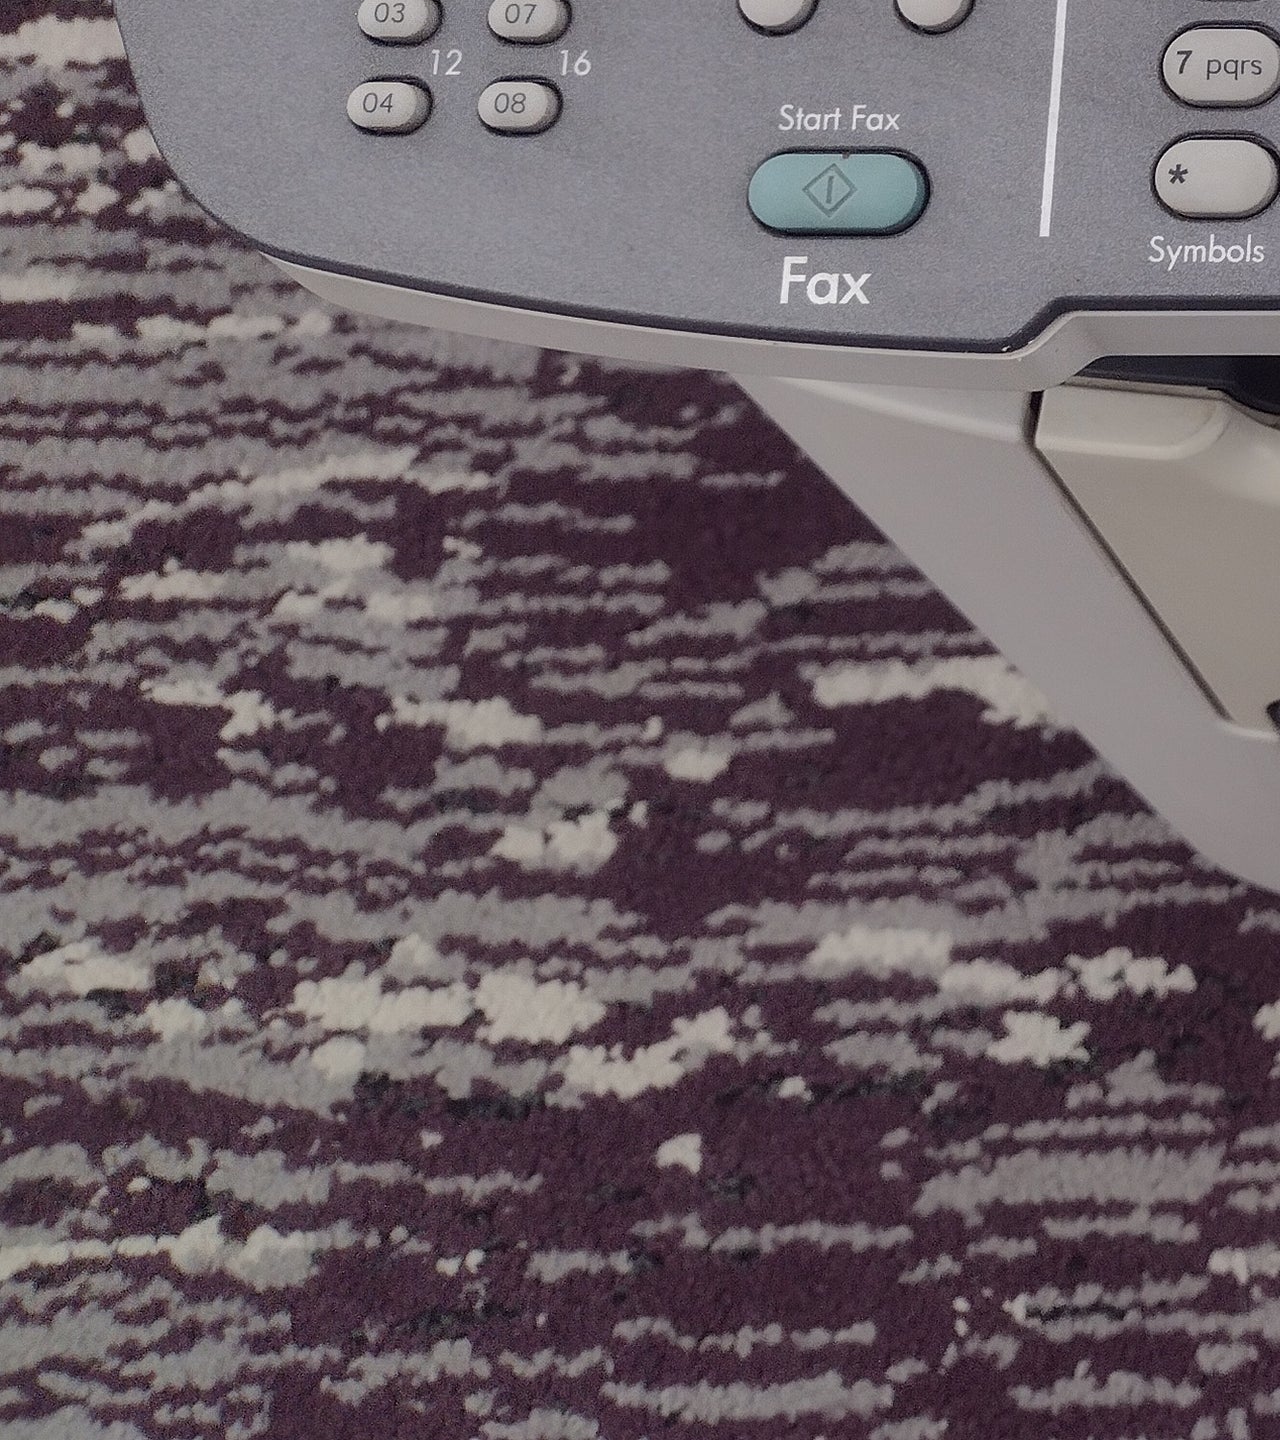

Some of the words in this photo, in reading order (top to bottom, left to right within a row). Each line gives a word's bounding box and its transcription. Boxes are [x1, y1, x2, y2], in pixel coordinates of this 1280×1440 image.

[374, 2, 406, 24] 03
[504, 3, 537, 25] 07
[431, 49, 463, 76] 12
[560, 49, 592, 77] 16
[1176, 50, 1193, 75] 7
[1206, 59, 1263, 81] pqrs
[362, 92, 394, 114] 04
[494, 92, 527, 115] 08
[778, 104, 842, 131] Start
[851, 104, 900, 132] Fax
[1148, 233, 1265, 271] Symbols
[779, 256, 872, 305] Fax
